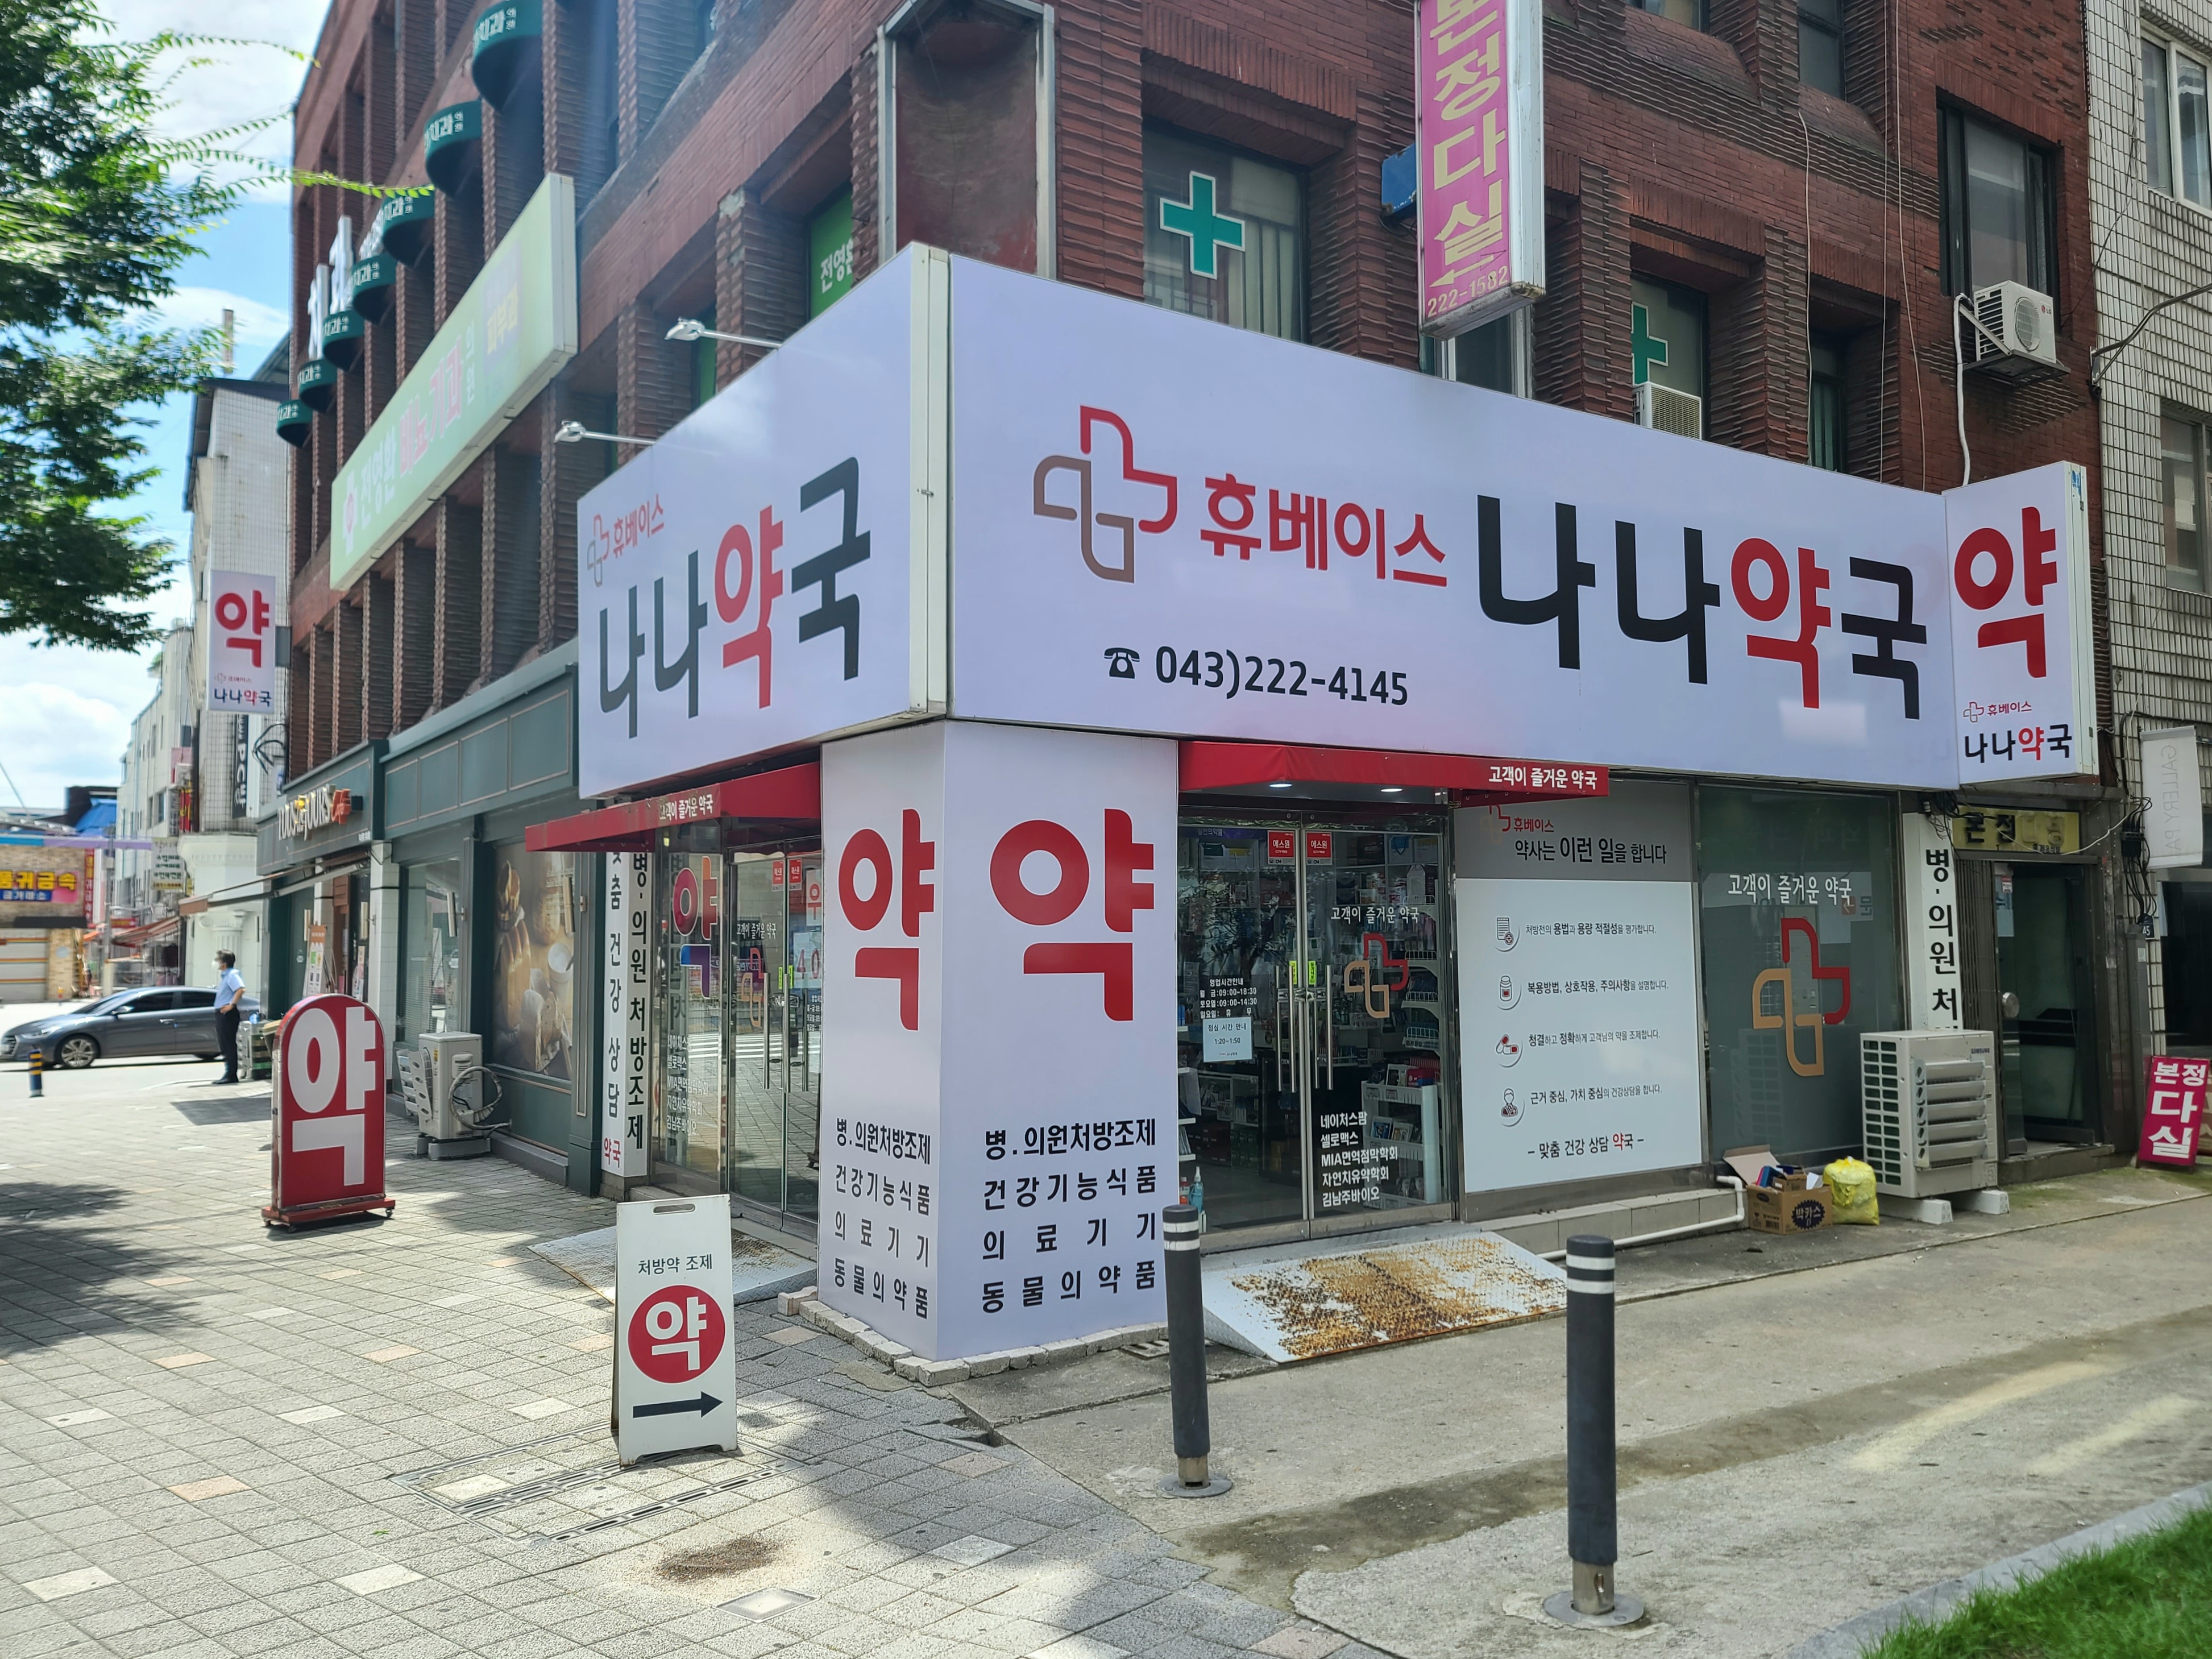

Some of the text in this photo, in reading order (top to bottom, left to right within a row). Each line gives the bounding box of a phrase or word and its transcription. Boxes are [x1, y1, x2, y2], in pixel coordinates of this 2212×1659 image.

[1429, 0, 1505, 266] 본정다실
[1427, 265, 1508, 318] 222-1582
[613, 493, 665, 558] 휴베이스
[1200, 472, 1448, 588] 휴베이스
[599, 456, 871, 740] 나나약국
[1477, 493, 1927, 720] 나나약국
[1953, 506, 2058, 679] 약
[214, 589, 270, 669] 약
[1155, 645, 1409, 706] 043)222-4145
[214, 688, 272, 707] 나나약국
[1987, 700, 2032, 716] 휴베이스
[1964, 723, 2073, 764] 나나약국
[1488, 766, 1597, 790] 고객이 즐거운 약국
[659, 794, 713, 821] 고객이 즐거운 약국
[1513, 816, 1554, 833] 휴베이스
[1272, 839, 1290, 849] 에스원
[1310, 840, 1327, 849] 에스원
[1515, 836, 1667, 864] 약사는 이런 일을 합니다
[1728, 873, 1853, 906] 고객이 즐거운 약국
[673, 856, 718, 999] 약
[837, 808, 935, 1031] 약
[989, 808, 1155, 1022] 약
[1331, 906, 1420, 924] 고객이 즐거운 약국
[1525, 922, 1657, 935] 처방전의 용법과 용량 적절성을 평가합니다.
[736, 922, 777, 939] 고객이 즐거운 약국
[1925, 849, 1958, 1030] 병·의원처
[609, 932, 622, 1013] 건강
[1209, 977, 1244, 987] 영업시간안내
[1527, 979, 1669, 995] 복용방법, 상호작용, 주의사항을 설명합니다.
[1528, 1029, 1661, 1047] 청결하고 정확하게 고객님의 약을 조제합니다.
[608, 1036, 620, 1118] 상담
[667, 1055, 687, 1071] 셀로맥스
[2153, 1062, 2206, 1086] 본정
[287, 1006, 376, 1187] 약
[667, 1095, 703, 1116] 자연치유약학회
[1530, 1084, 1662, 1105] 근거 중심, 가치 중심의 건강상담을 합니다.
[666, 1115, 697, 1135] 김남주바이오
[1320, 1111, 1368, 1129] 네이처스팜
[2148, 1090, 2198, 1159] 다실
[603, 1137, 621, 1168] 약국
[1320, 1131, 1359, 1149] 셀로맥스
[1539, 1132, 1634, 1159] 맞춤 건강 상담 약국
[1321, 1146, 1398, 1167] MIA면역점막학회
[835, 1164, 930, 1216] 건강기능식품
[984, 1164, 1157, 1211] 건강기능식품
[1322, 1166, 1389, 1187] 자연치유약학회
[1322, 1186, 1380, 1208] 김남주바이오
[1795, 1205, 1821, 1220] 박카스
[835, 1210, 929, 1268] 의료기기
[982, 1212, 1156, 1260] 의료기기
[638, 1253, 713, 1276] 처방약 조제
[834, 1256, 928, 1320] 동물의약품
[982, 1259, 1156, 1314] 동물의약품
[646, 1296, 707, 1371] 약
